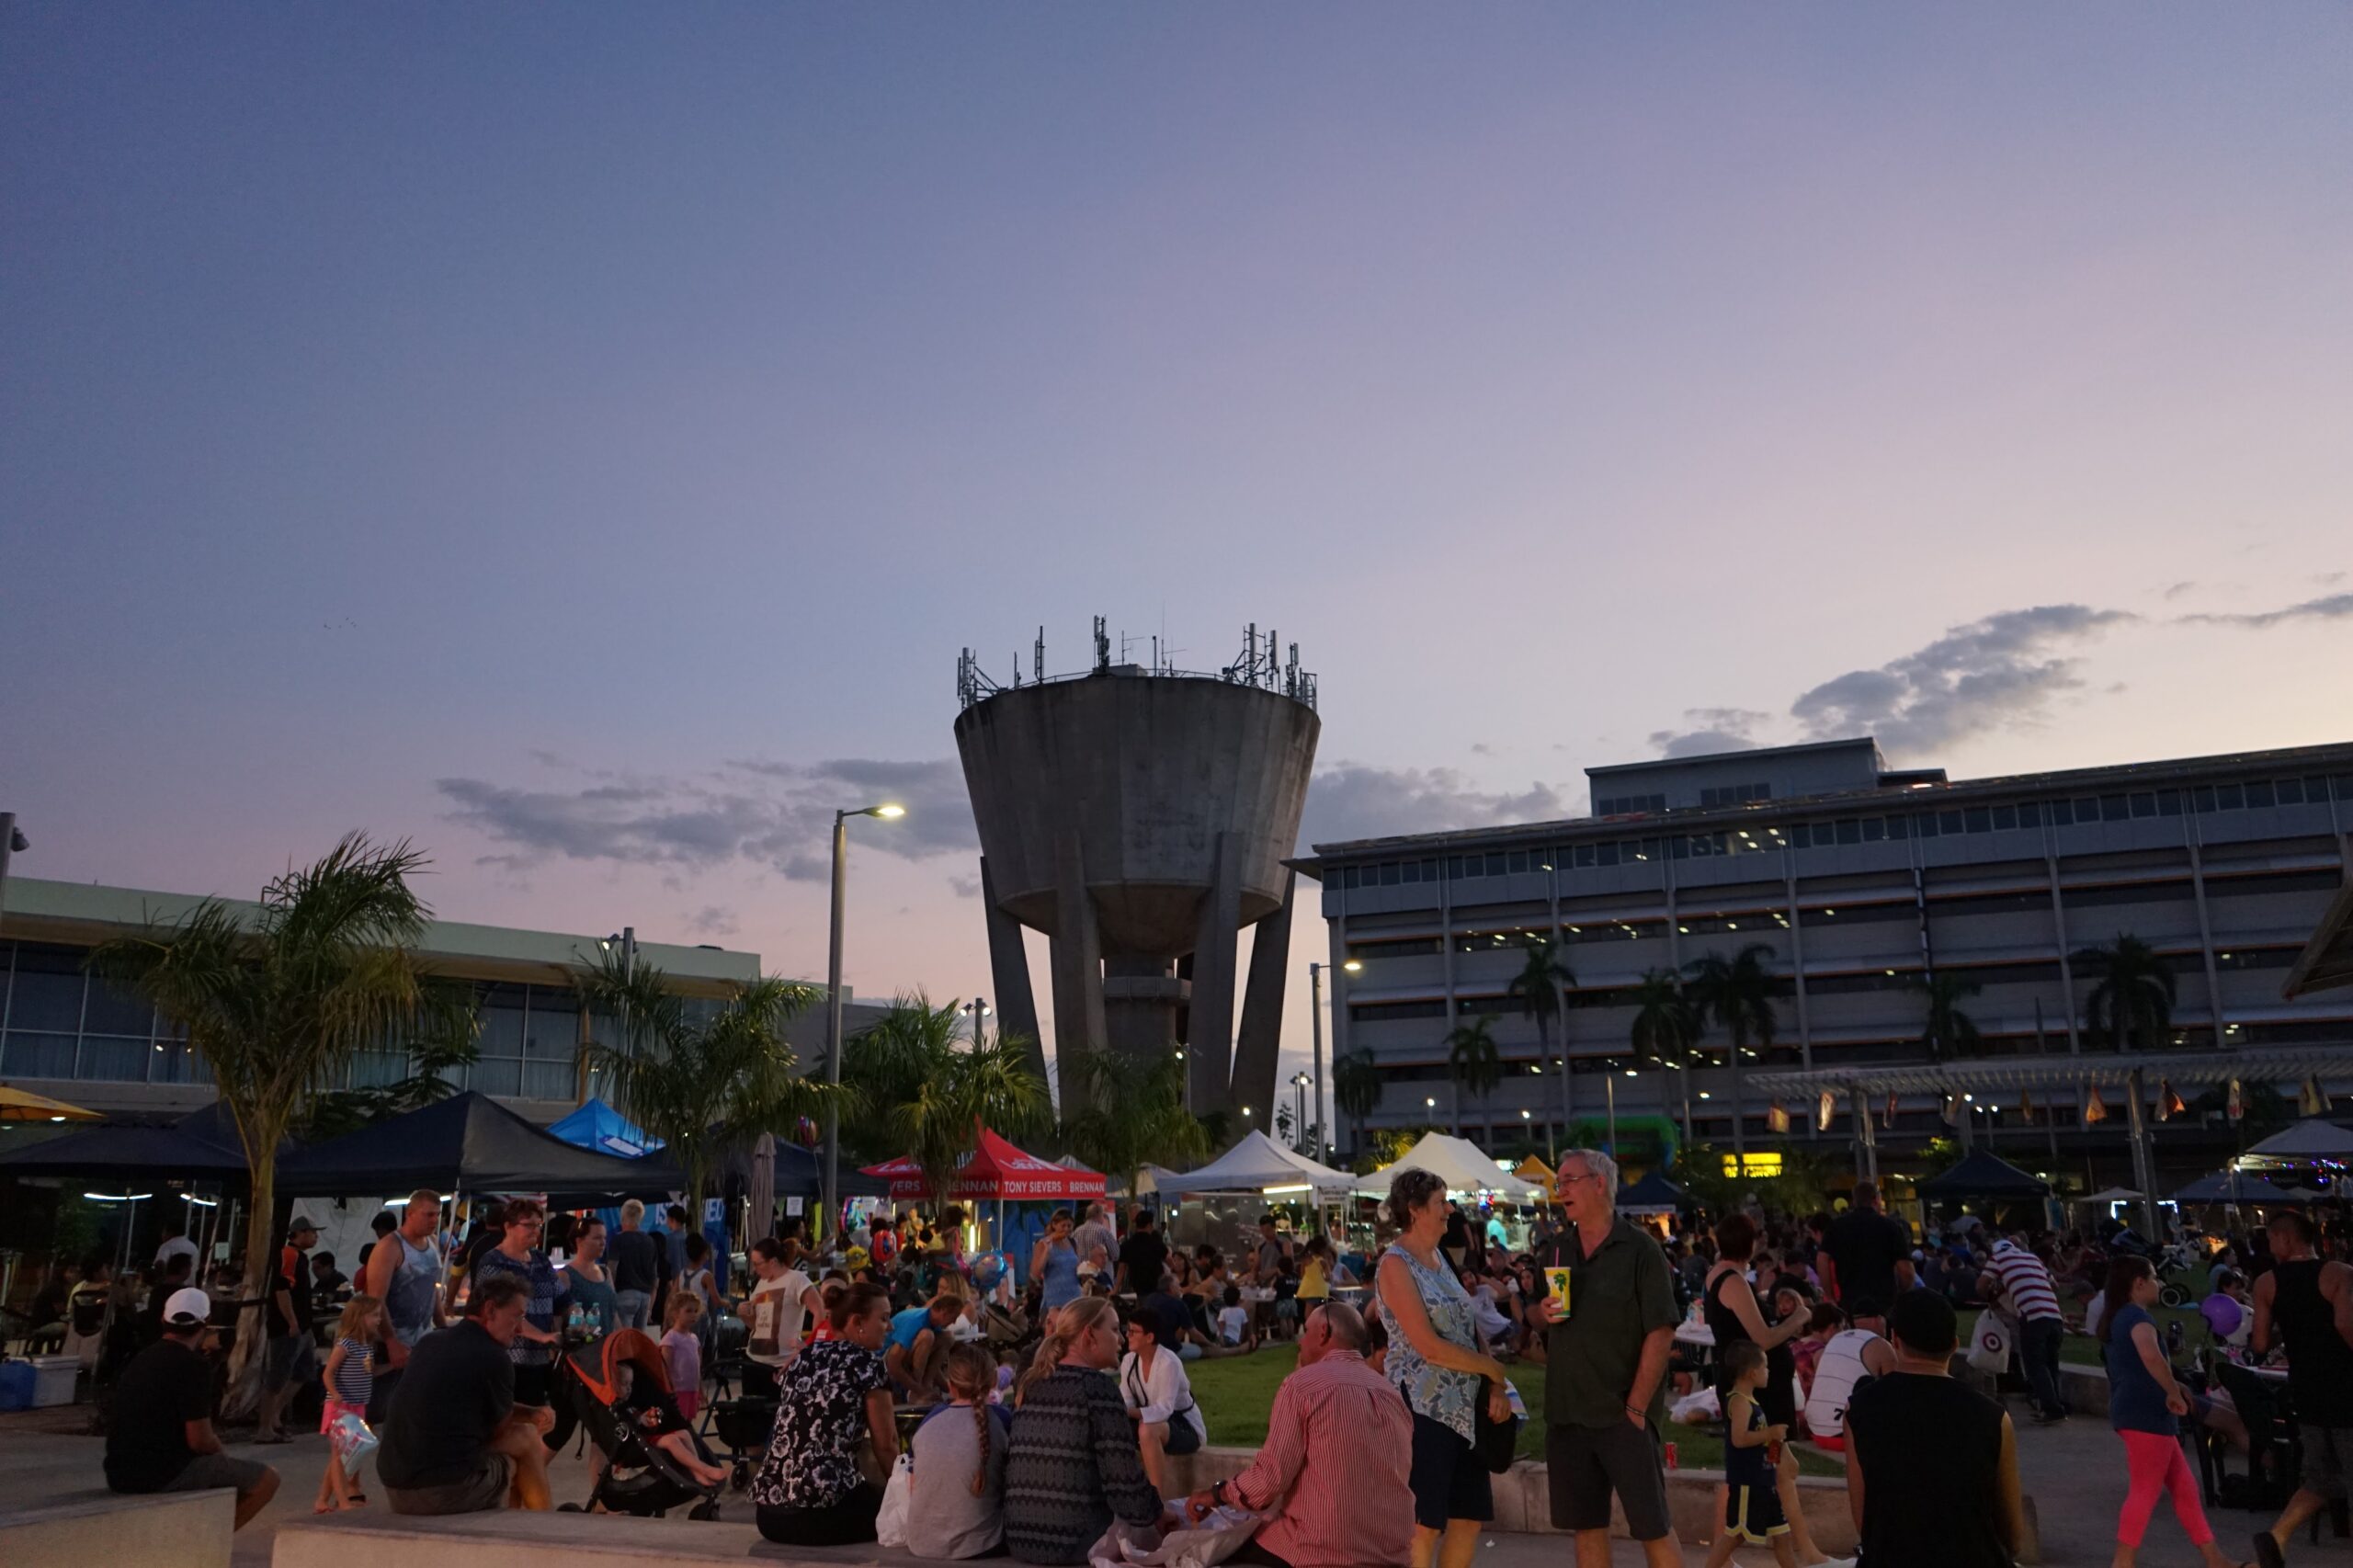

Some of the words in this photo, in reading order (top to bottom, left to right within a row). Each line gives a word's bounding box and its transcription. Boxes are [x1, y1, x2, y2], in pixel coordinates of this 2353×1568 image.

[1005, 1181, 1028, 1193] TONY
[1029, 1180, 1063, 1193] SIEVERS
[1069, 1181, 1105, 1193] BRENNAN
[1834, 1407, 1844, 1421] 7
